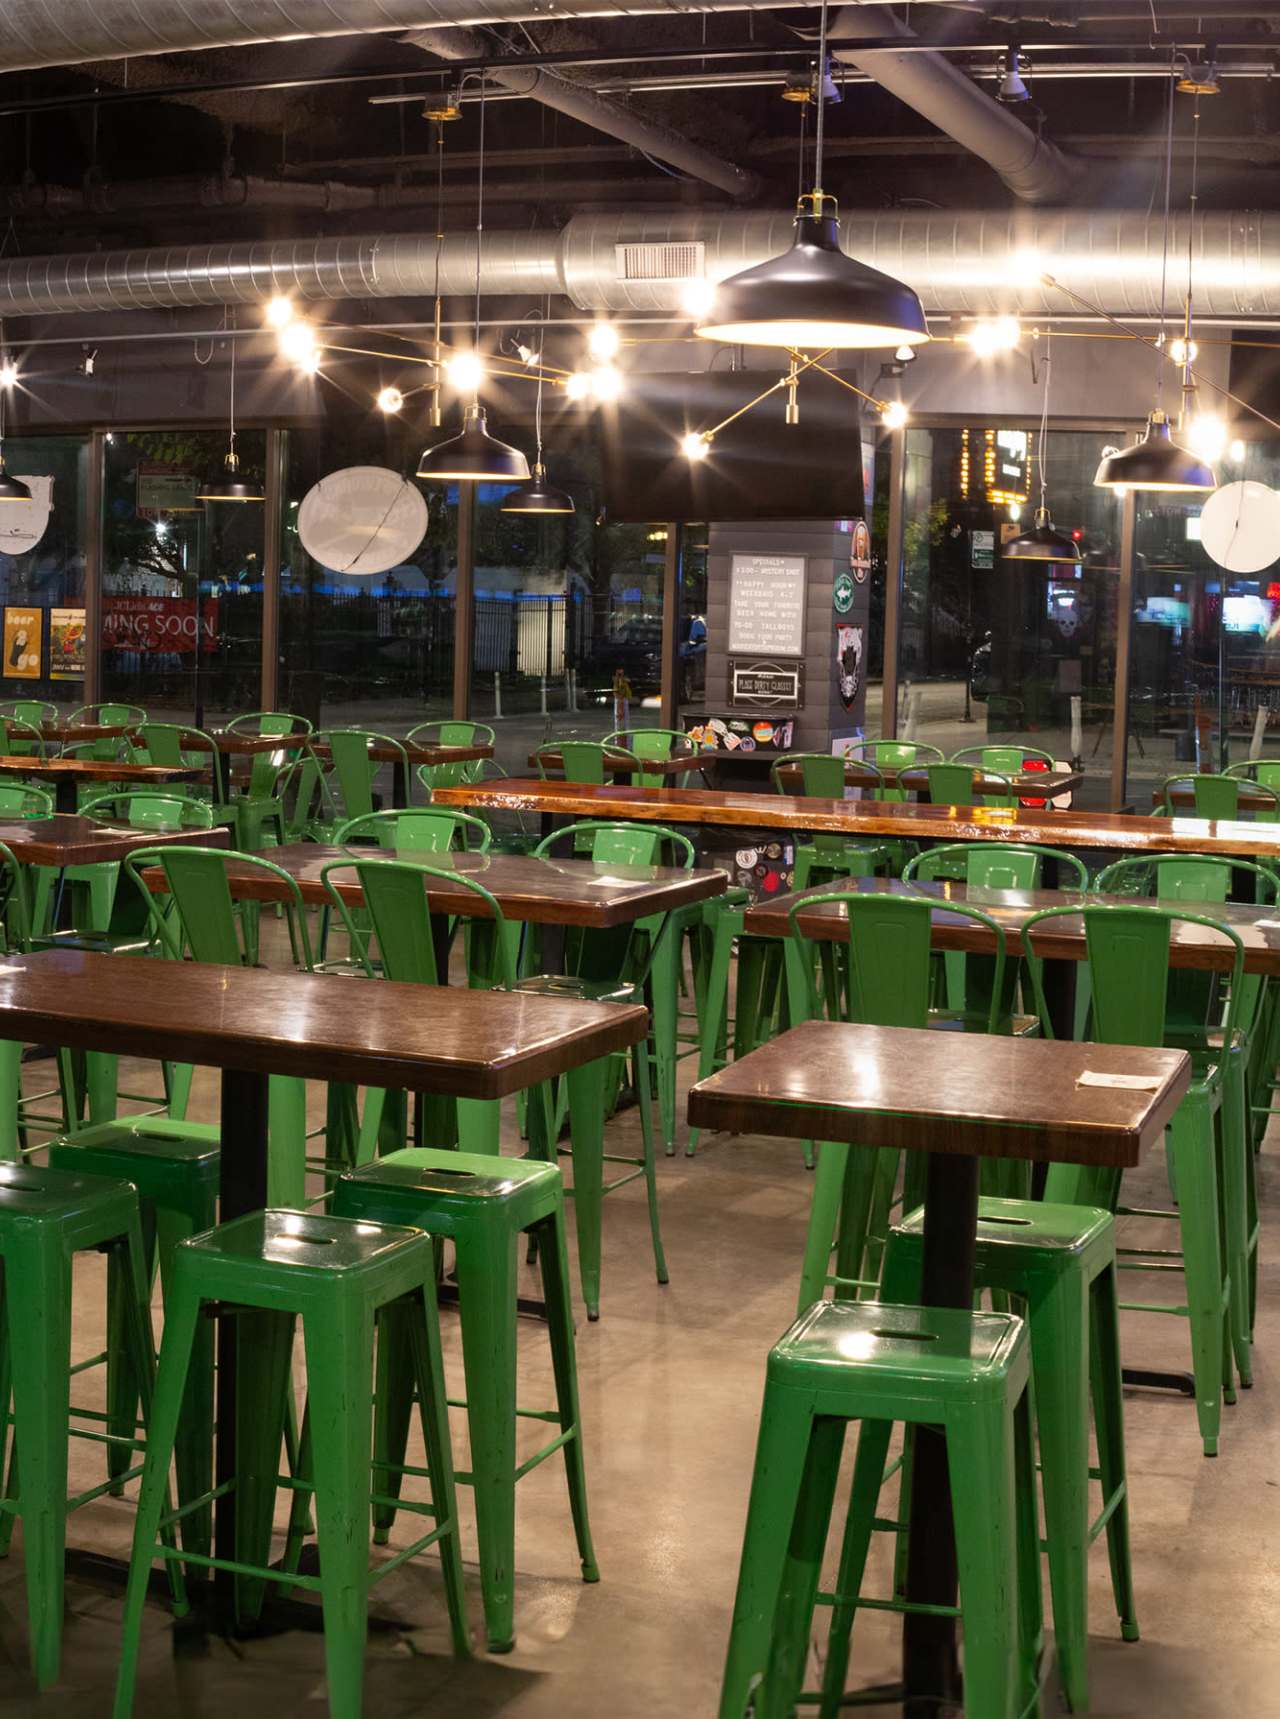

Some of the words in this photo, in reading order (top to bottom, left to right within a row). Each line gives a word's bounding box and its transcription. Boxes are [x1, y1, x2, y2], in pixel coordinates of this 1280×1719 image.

[7, 612, 34, 625] beer
[155, 614, 214, 637] SOON
[754, 680, 770, 690] DIRTY
